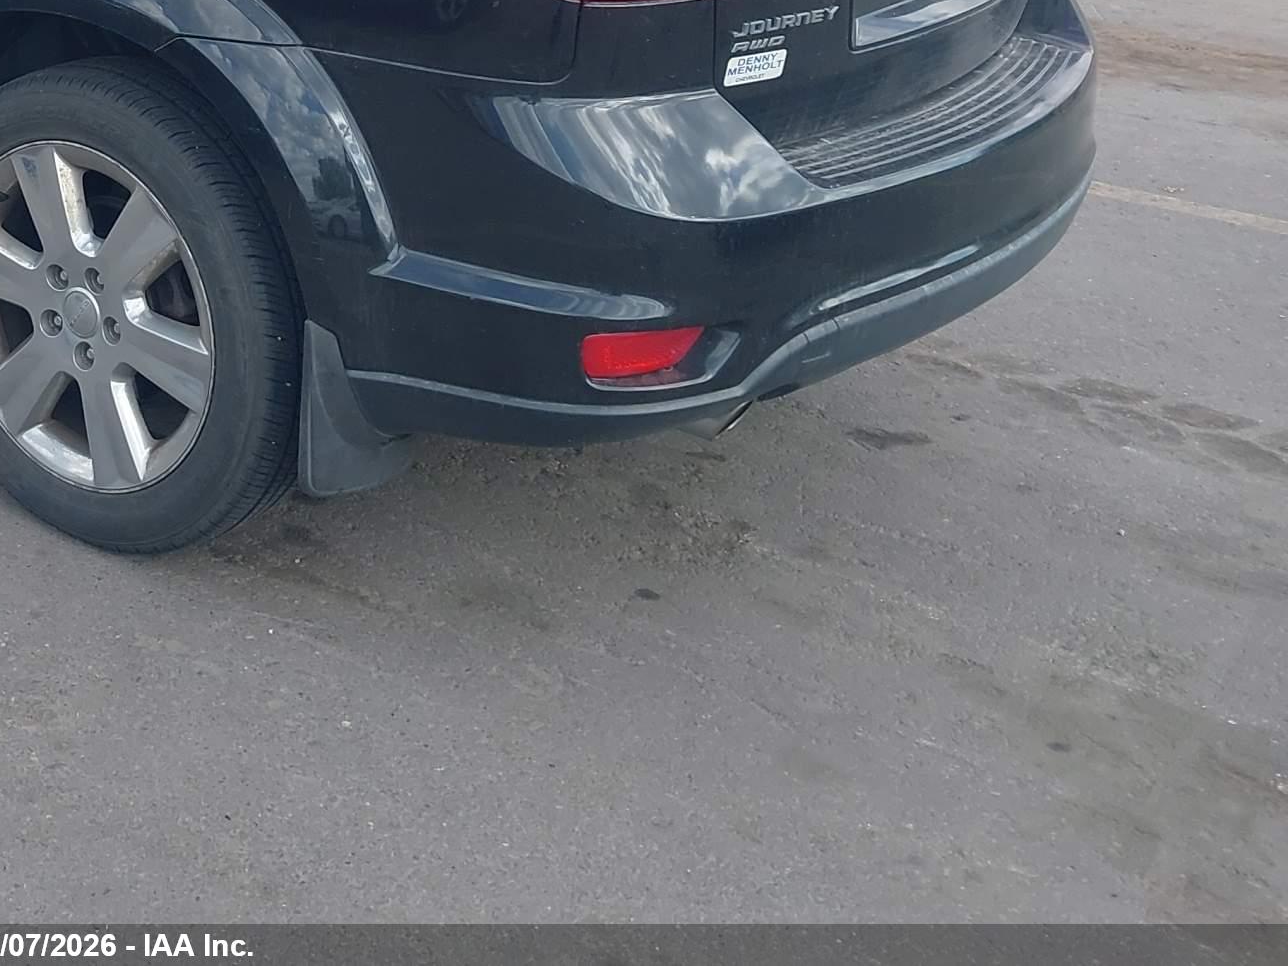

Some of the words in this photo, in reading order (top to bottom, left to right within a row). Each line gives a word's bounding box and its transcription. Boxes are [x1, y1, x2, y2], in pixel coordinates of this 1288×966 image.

[730, 5, 840, 38] JOURNEY
[730, 35, 786, 53] AWD
[727, 60, 784, 76] MENHOLT
[737, 53, 778, 67] DENNY
